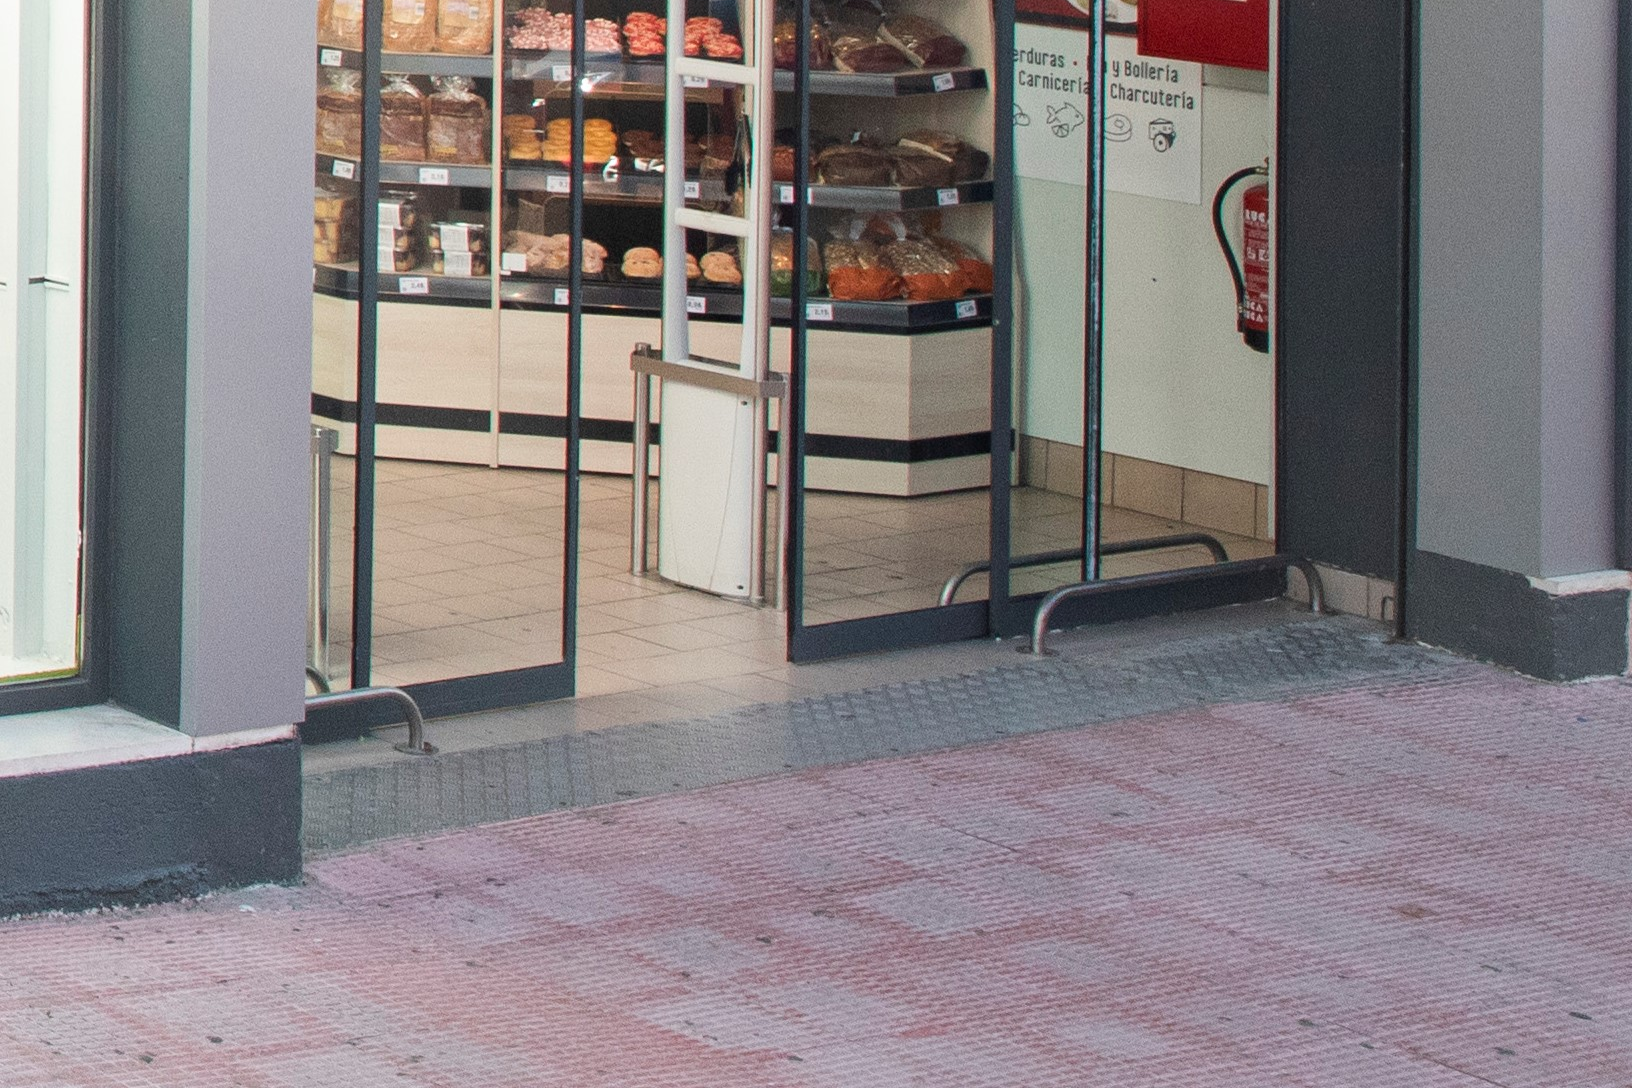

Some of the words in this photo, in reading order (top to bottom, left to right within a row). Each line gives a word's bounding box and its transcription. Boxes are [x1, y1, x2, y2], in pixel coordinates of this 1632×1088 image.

[1014, 47, 1065, 68] erduras
[1112, 61, 1120, 78] y
[1124, 60, 1179, 84] Bollería
[1018, 70, 1090, 95] Carnicería
[1110, 83, 1195, 110] Charcutería
